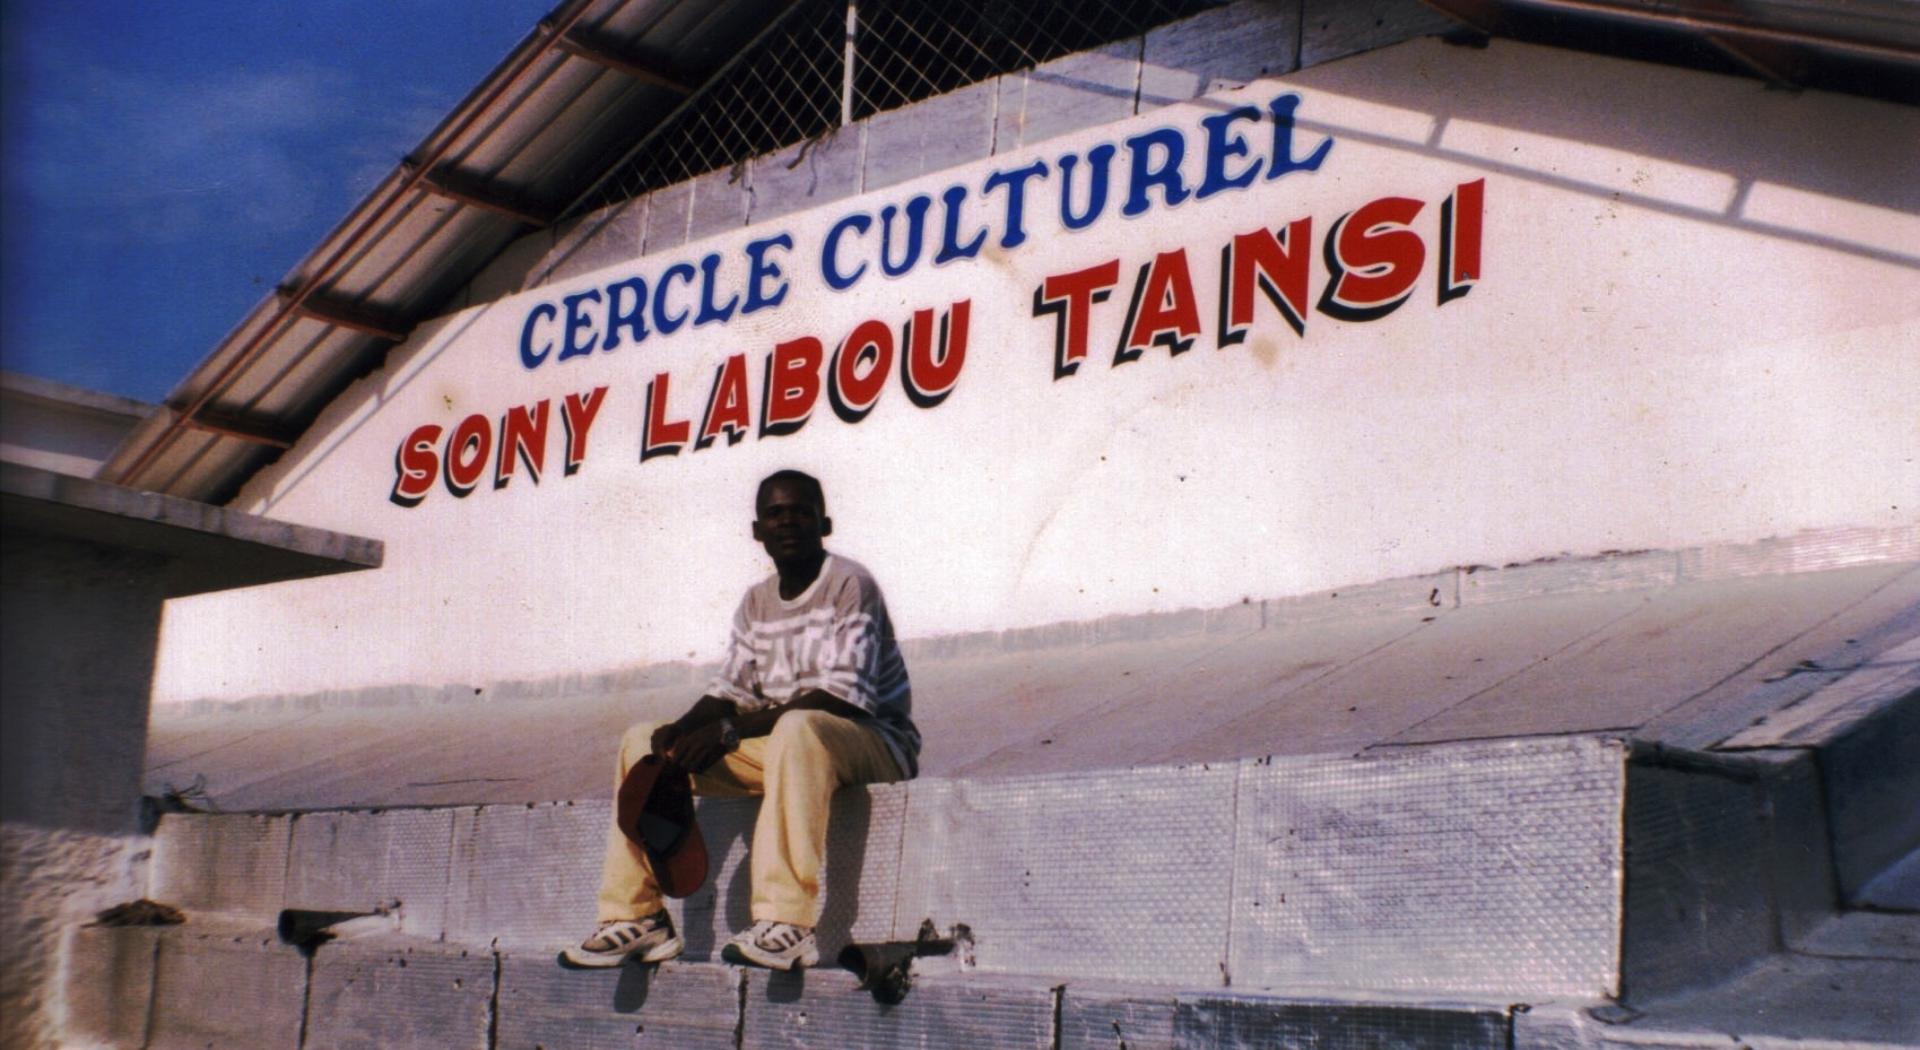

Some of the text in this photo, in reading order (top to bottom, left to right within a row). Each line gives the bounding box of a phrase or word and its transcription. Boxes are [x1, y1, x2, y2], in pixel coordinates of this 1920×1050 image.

[389, 177, 1486, 509] SONY LABOU TANSI
[519, 93, 1334, 371] CERCLE CULTUREL
